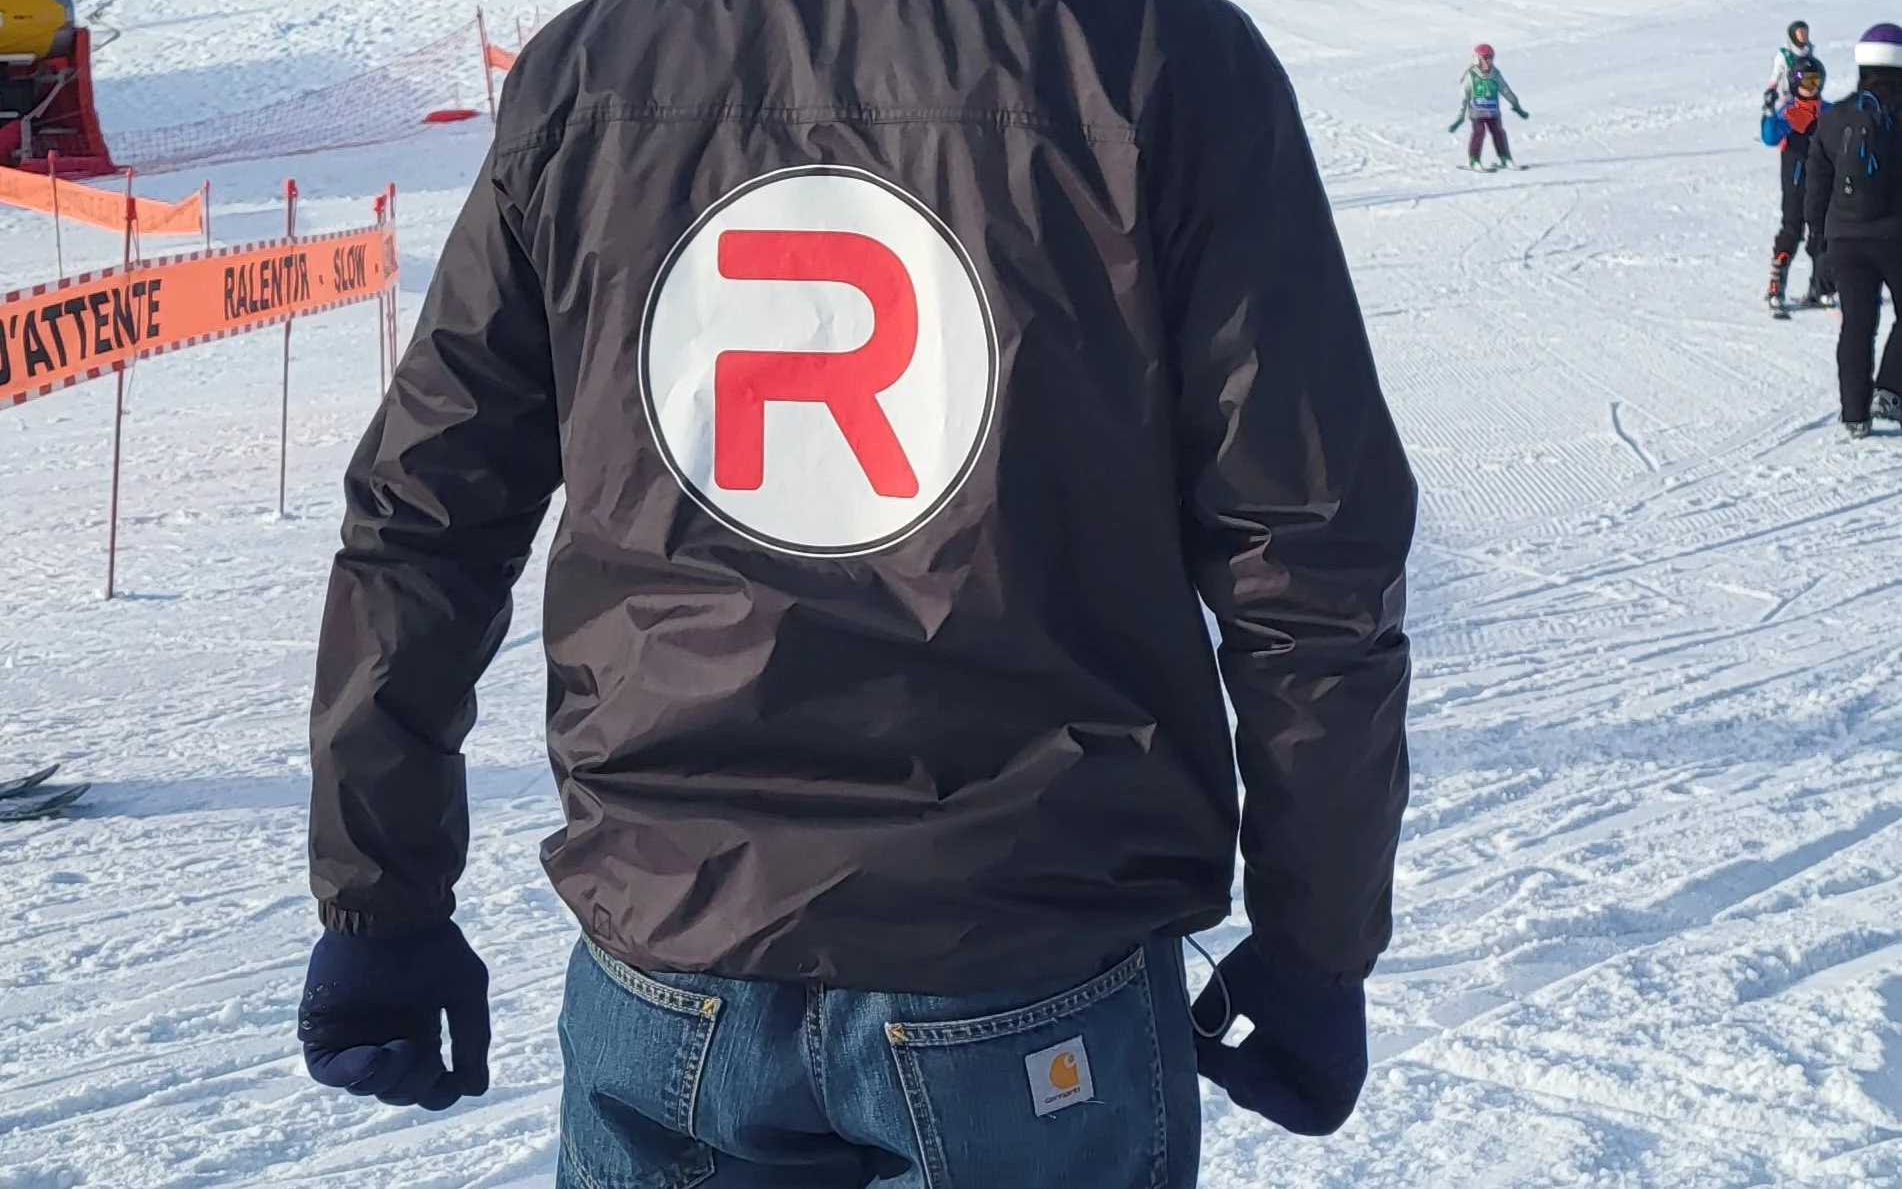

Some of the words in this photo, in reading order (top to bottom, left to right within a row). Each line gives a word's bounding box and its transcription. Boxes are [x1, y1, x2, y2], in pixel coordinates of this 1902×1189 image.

[225, 253, 310, 320] RALENTIR
[334, 243, 366, 293] SLOW
[715, 230, 919, 498] R
